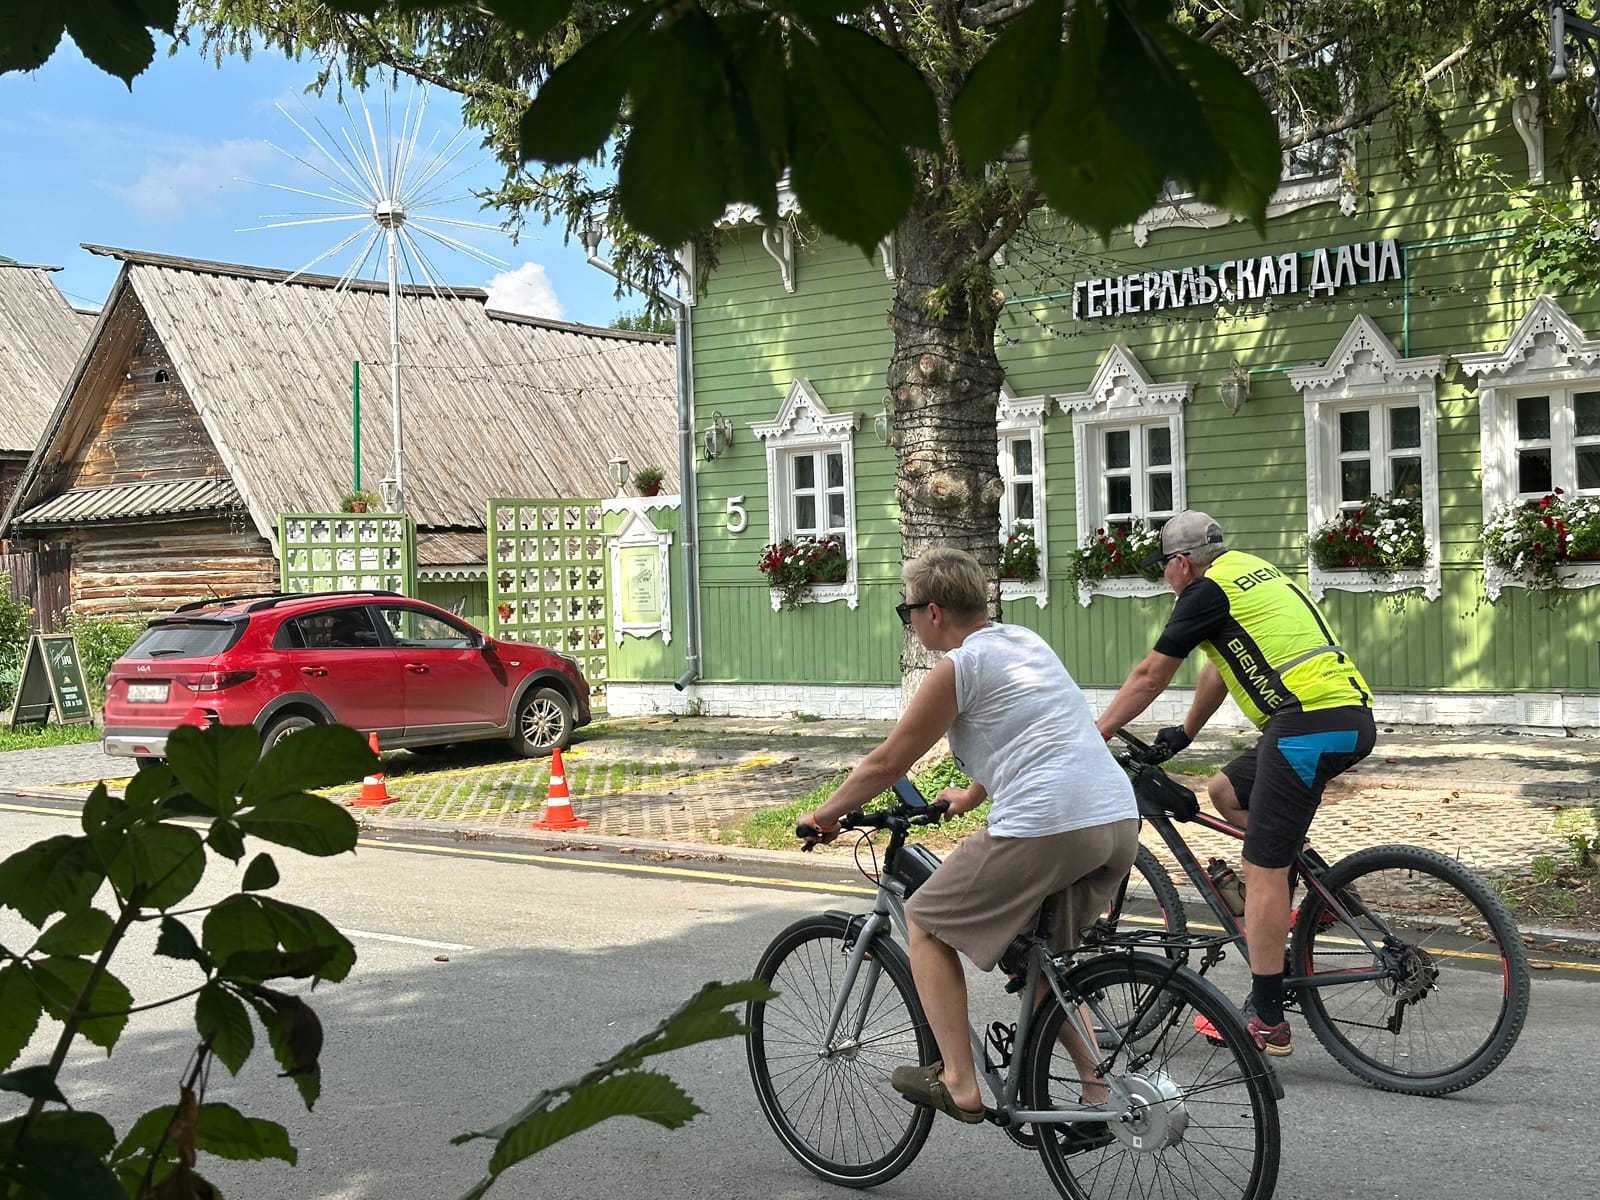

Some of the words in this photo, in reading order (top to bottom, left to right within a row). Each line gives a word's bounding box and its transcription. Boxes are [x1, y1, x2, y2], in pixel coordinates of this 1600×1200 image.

[1072, 252, 1298, 320] ГЕНЕРАЛЬСКАЯ
[1309, 238, 1401, 296] ДАЧА
[726, 495, 748, 533] 5
[1227, 638, 1283, 709] BIEMME
